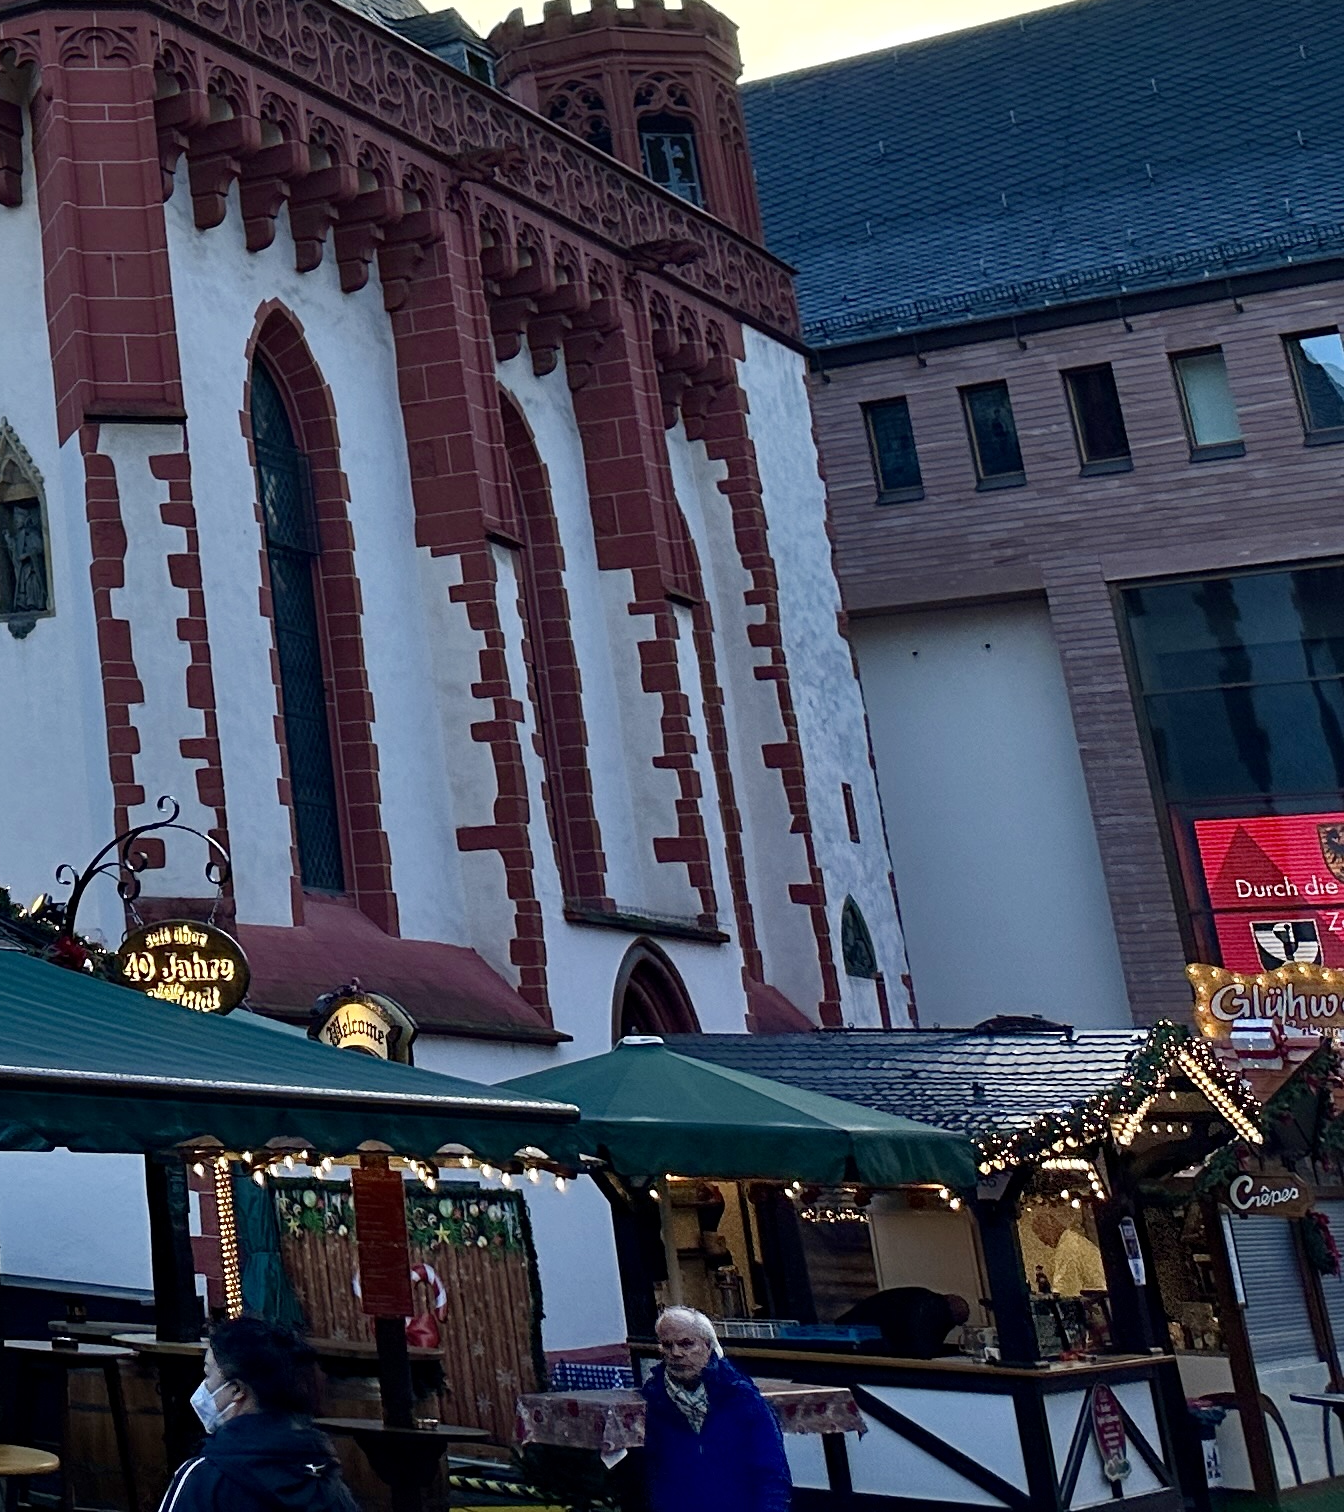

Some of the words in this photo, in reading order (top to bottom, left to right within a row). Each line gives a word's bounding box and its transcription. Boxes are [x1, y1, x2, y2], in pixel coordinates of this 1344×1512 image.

[1235, 876, 1299, 899] Durch
[1305, 875, 1338, 896] die
[123, 952, 157, 982] 40
[162, 951, 235, 982] Jahre
[1210, 983, 1344, 1022] Glühw
[326, 1010, 385, 1047] Welcome
[1229, 1174, 1300, 1210] Crêpes
